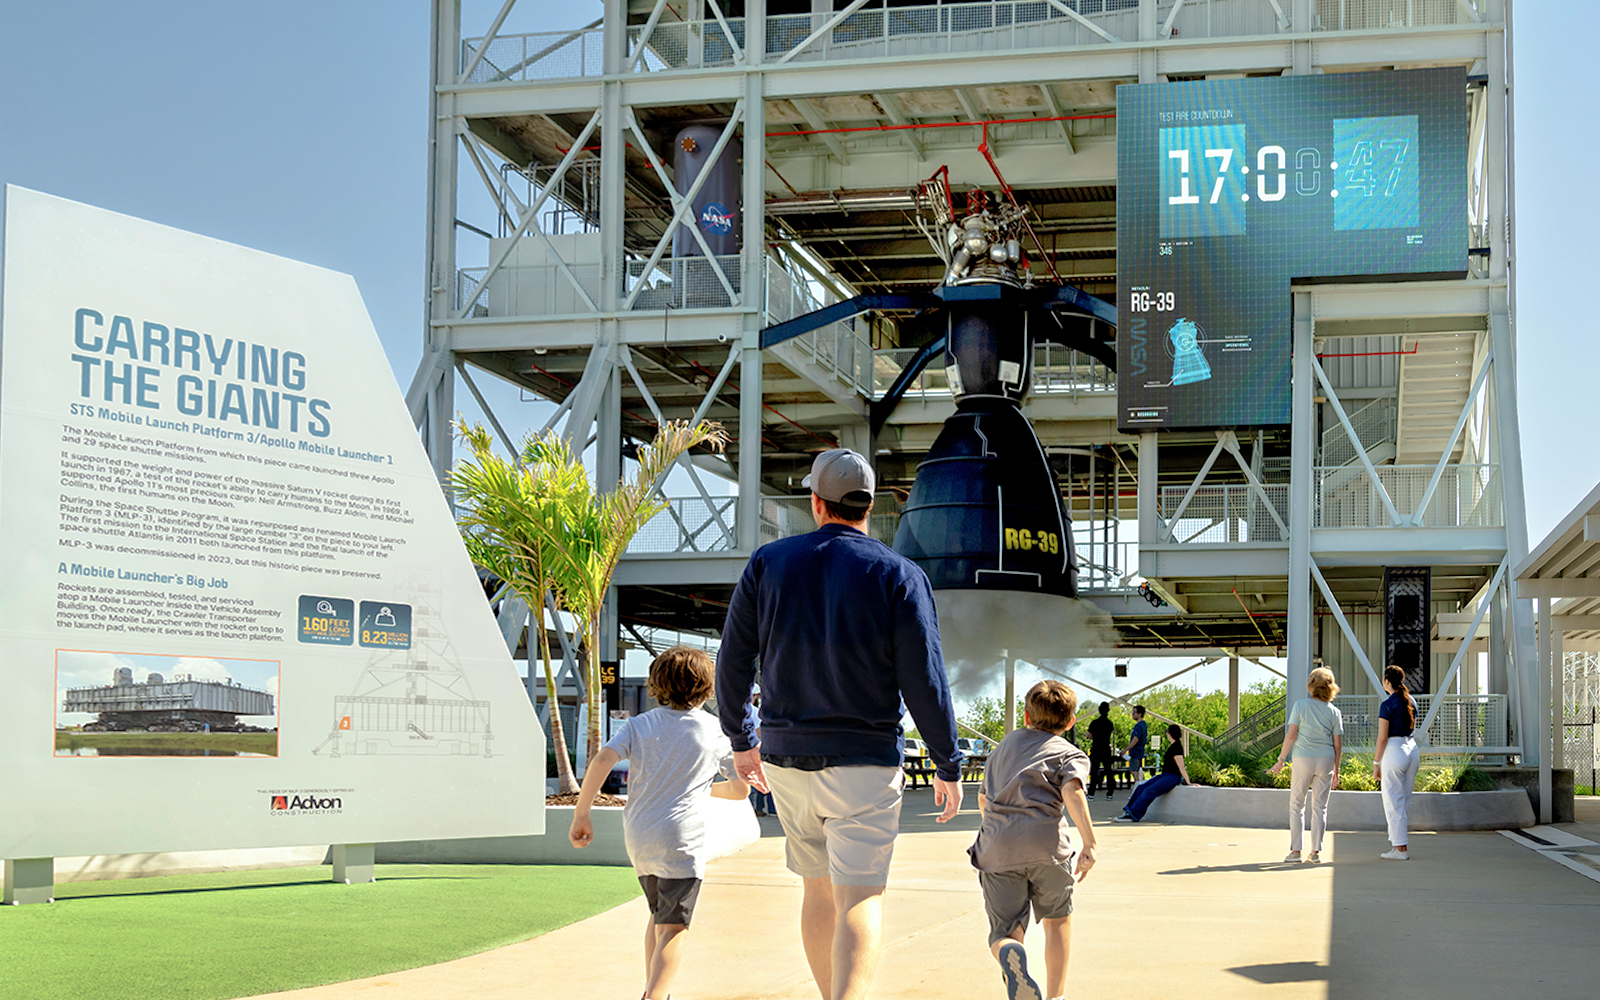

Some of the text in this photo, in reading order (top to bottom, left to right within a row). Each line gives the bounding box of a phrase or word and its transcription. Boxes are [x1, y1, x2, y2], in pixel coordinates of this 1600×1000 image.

[1159, 108, 1234, 121] TEST FIRE COUNTDOWN
[702, 212, 732, 229] NASA
[1131, 292, 1175, 312] RG-39
[74, 307, 306, 391] CARRYING
[1130, 318, 1147, 377] NASA
[71, 353, 332, 438] THE GIANTS
[61, 435, 81, 443] and
[83, 437, 96, 446] 29
[98, 441, 128, 450] space
[130, 445, 162, 456] shuttle
[70, 403, 393, 465] STS Mobile Launch Platform 3/Apollo Mobile Launcher 1
[63, 424, 395, 484] The Mobile Launch Platform from which this piece came launched three Apollo
[60, 470, 112, 482] supported
[114, 476, 144, 487] Apollo
[164, 484, 188, 493] most
[189, 488, 228, 498] precious
[258, 496, 275, 504] Neil
[323, 505, 342, 514] Buzz
[385, 514, 414, 524] Michael
[99, 483, 115, 492] the
[117, 485, 136, 495] first
[138, 488, 176, 500] humans
[191, 496, 206, 504] the
[59, 494, 93, 507] During
[95, 499, 112, 508] the
[113, 501, 144, 512] Space
[145, 505, 179, 516] Shuttle
[230, 517, 248, 525] was
[250, 520, 298, 531] repurposed
[316, 528, 351, 538] renamed
[352, 532, 377, 541] Mobile
[379, 535, 406, 544] Launch
[59, 523, 89, 532] space
[91, 526, 125, 536] shuttle
[127, 530, 163, 540] Atlantis
[165, 534, 174, 542] in
[176, 535, 196, 544] 2011
[198, 538, 219, 546] both
[221, 540, 260, 551] launched
[262, 545, 282, 554] from
[283, 548, 298, 556] this
[60, 512, 79, 522] The
[81, 515, 101, 524] first
[103, 519, 140, 528] mission
[154, 524, 170, 532] the
[171, 526, 227, 539] International
[229, 533, 256, 542] Space
[257, 536, 287, 546] Station
[306, 542, 319, 550] the
[321, 543, 338, 552] final
[339, 546, 365, 555] launch
[1004, 527, 1059, 554] RG-39
[58, 538, 92, 548] MLP-3
[94, 543, 114, 551] was
[116, 546, 195, 559] decommissioned
[234, 557, 249, 565] but
[251, 559, 267, 567] this
[268, 561, 299, 570] historic
[300, 565, 323, 573] piece
[57, 562, 228, 588] A Mobile Launcher's Big Job
[56, 592, 80, 601] atop
[89, 594, 121, 603] Mobile
[122, 597, 164, 607] Launcher
[166, 601, 192, 609] inside
[209, 604, 240, 613] Vehicle
[242, 607, 281, 617] Assembly
[57, 582, 96, 592] Rockets
[200, 595, 217, 603] and
[218, 597, 254, 606] serviced
[99, 604, 124, 613] Once
[156, 609, 171, 617] the
[172, 609, 206, 619] Crawler
[208, 612, 256, 622] Transporter
[302, 616, 350, 632] 160 FEET
[329, 626, 350, 634] LONG
[362, 630, 388, 645] 8.23
[601, 666, 615, 675] LC
[601, 675, 616, 684] 39
[289, 795, 342, 810] Advon
